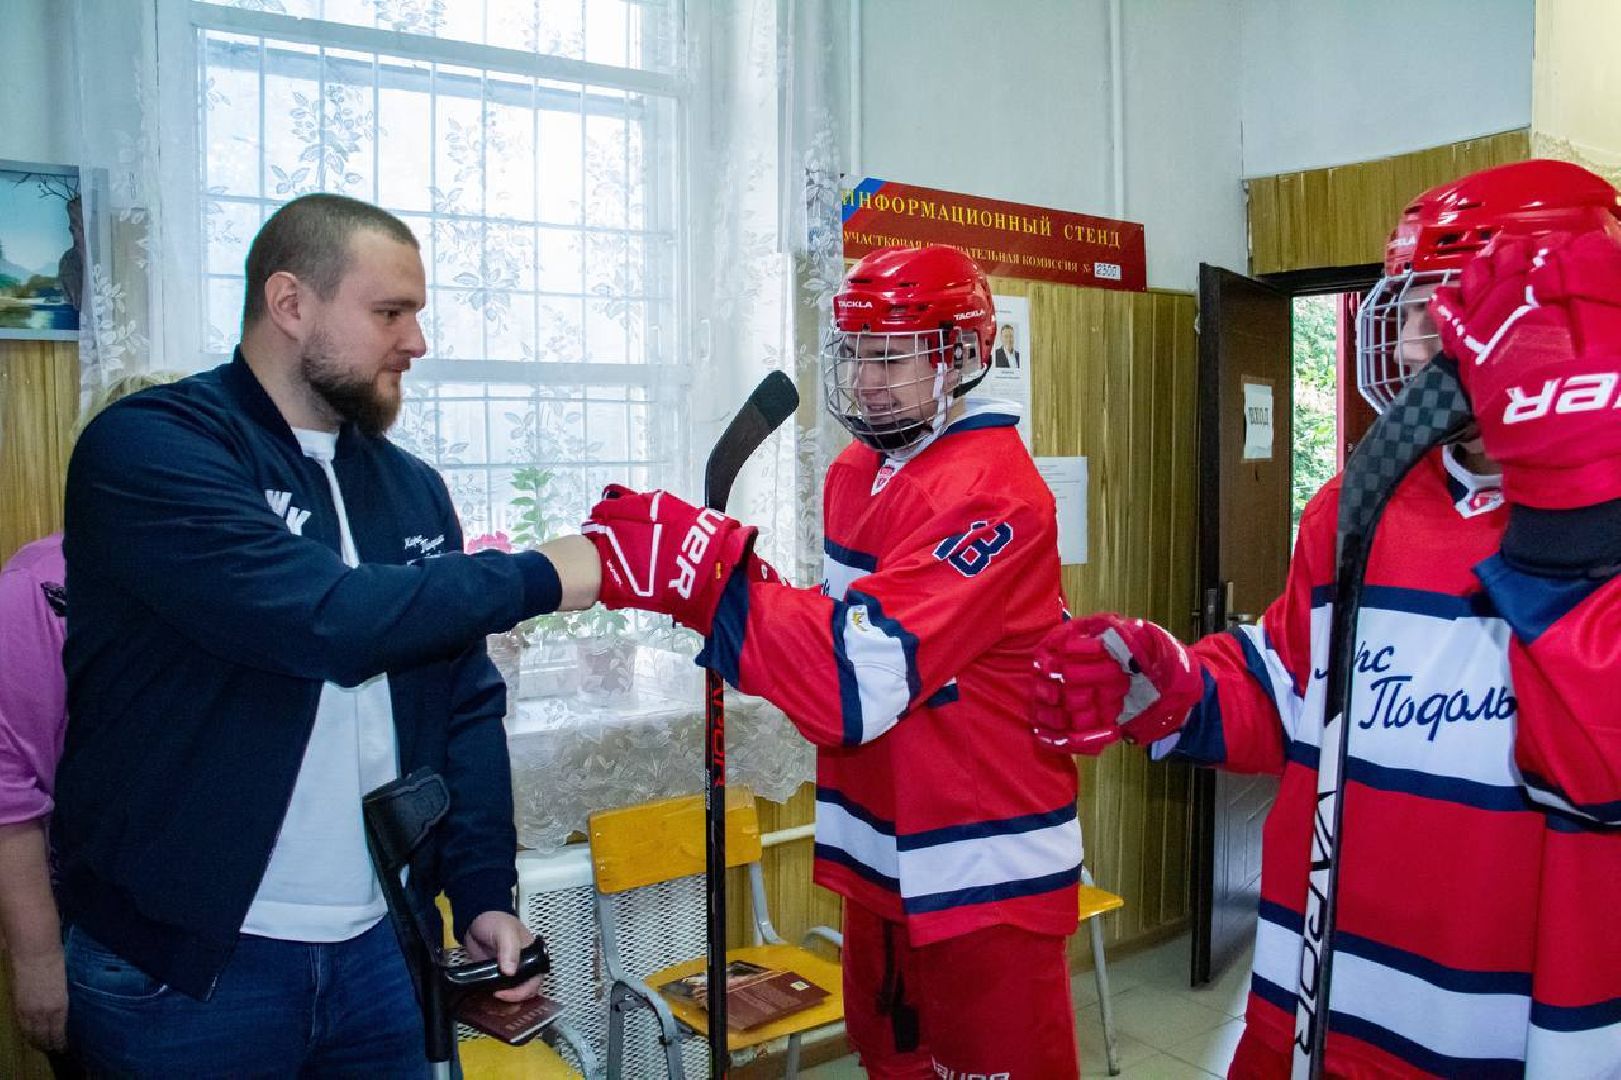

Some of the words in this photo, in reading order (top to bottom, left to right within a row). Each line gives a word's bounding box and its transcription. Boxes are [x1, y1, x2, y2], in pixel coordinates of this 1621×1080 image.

[842, 190, 1052, 236] ИНФОРМАЦИОННЫЙ
[1064, 223, 1120, 249] СТЕНД
[926, 242, 1020, 265] АТЕЛЬНАЯ
[1023, 254, 1078, 273] КОМИССИЯ
[838, 300, 873, 309] TACKLA
[953, 309, 986, 322] TACKLA
